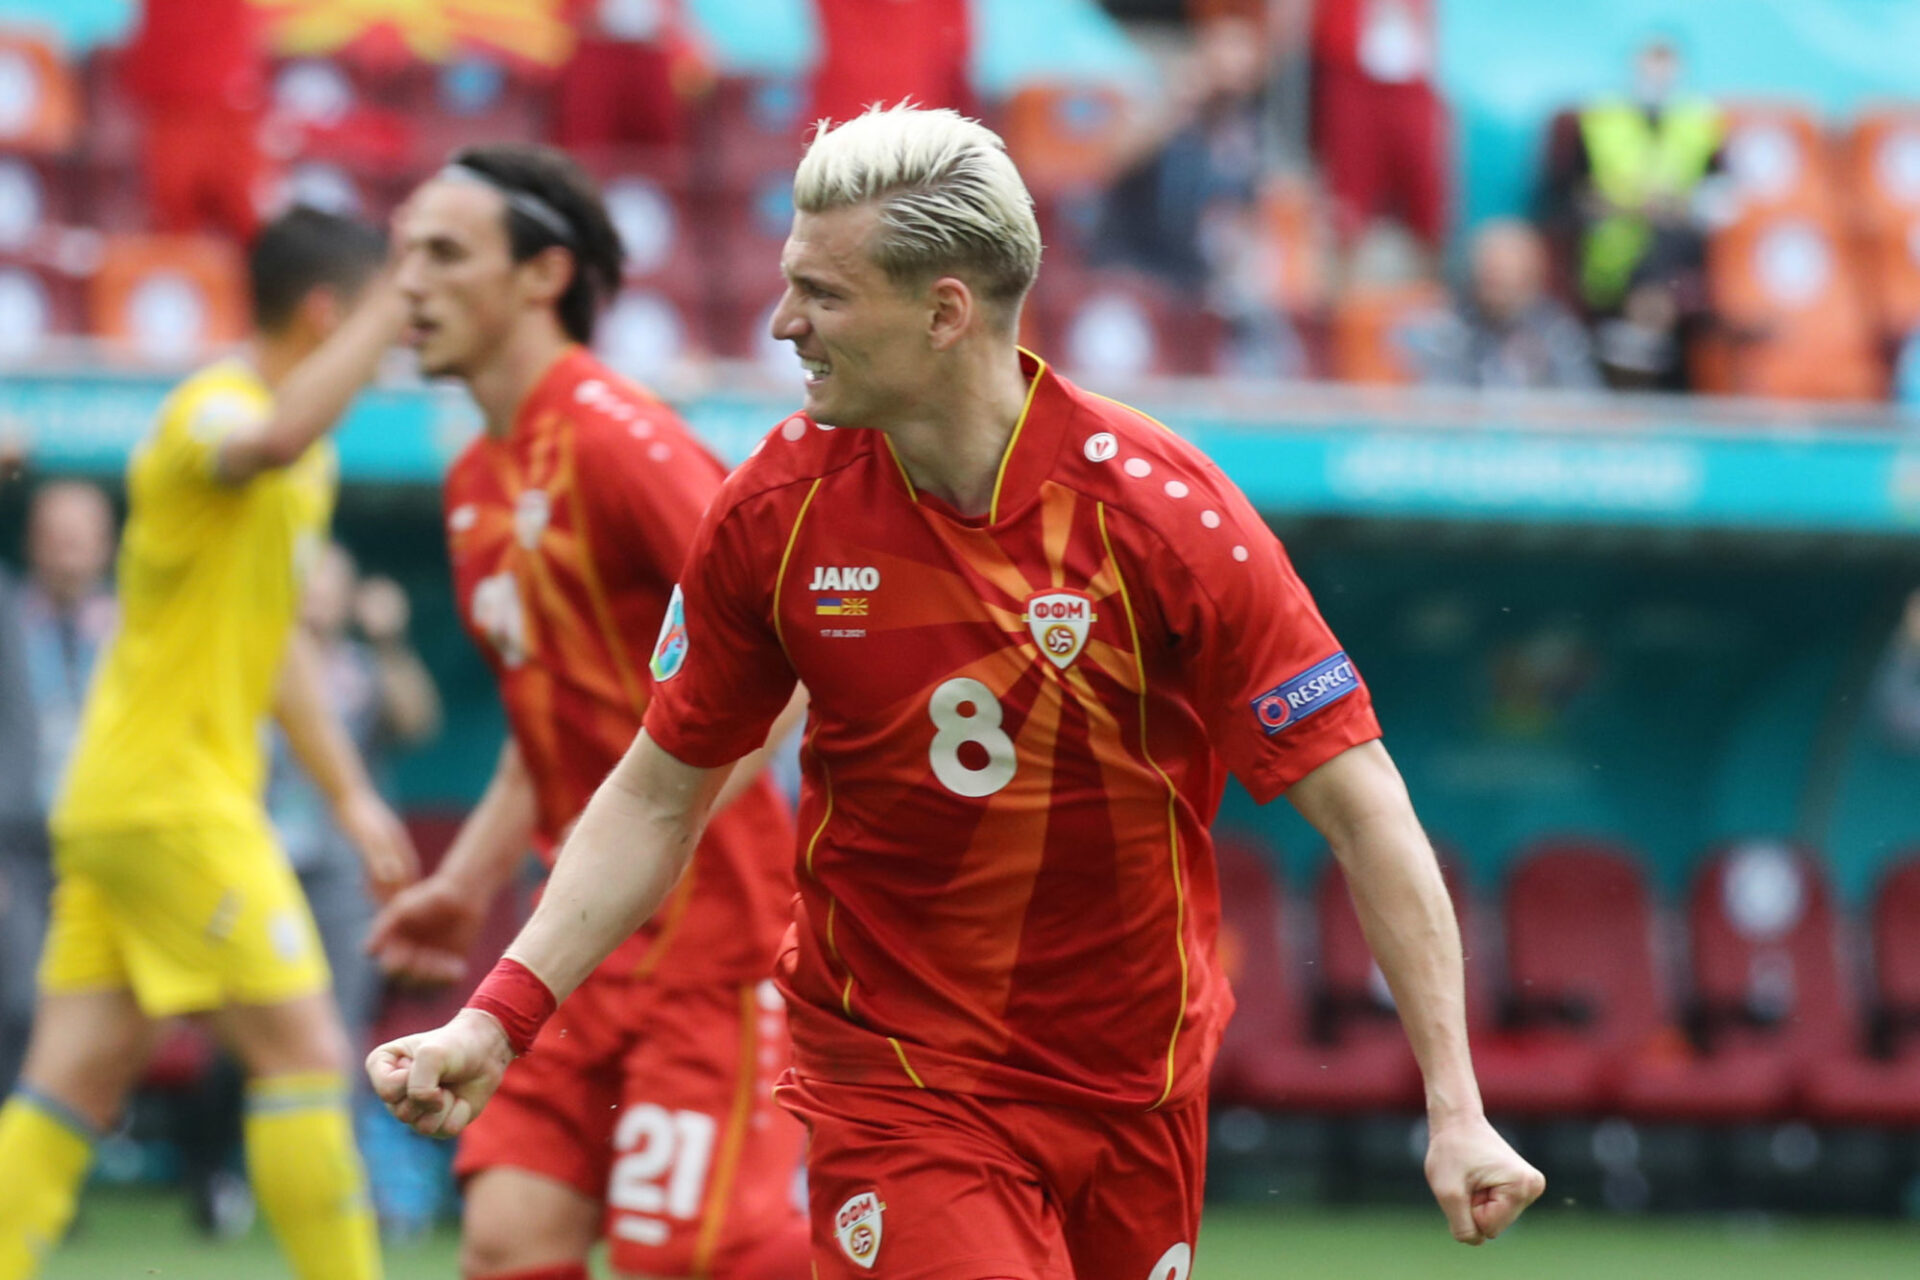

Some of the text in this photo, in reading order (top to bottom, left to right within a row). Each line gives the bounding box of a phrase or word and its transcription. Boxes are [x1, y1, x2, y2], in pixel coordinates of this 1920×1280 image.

[809, 566, 880, 591] JAKO
[1286, 660, 1354, 709] RESPECT
[928, 677, 1017, 798] 8
[608, 1102, 716, 1220] 21
